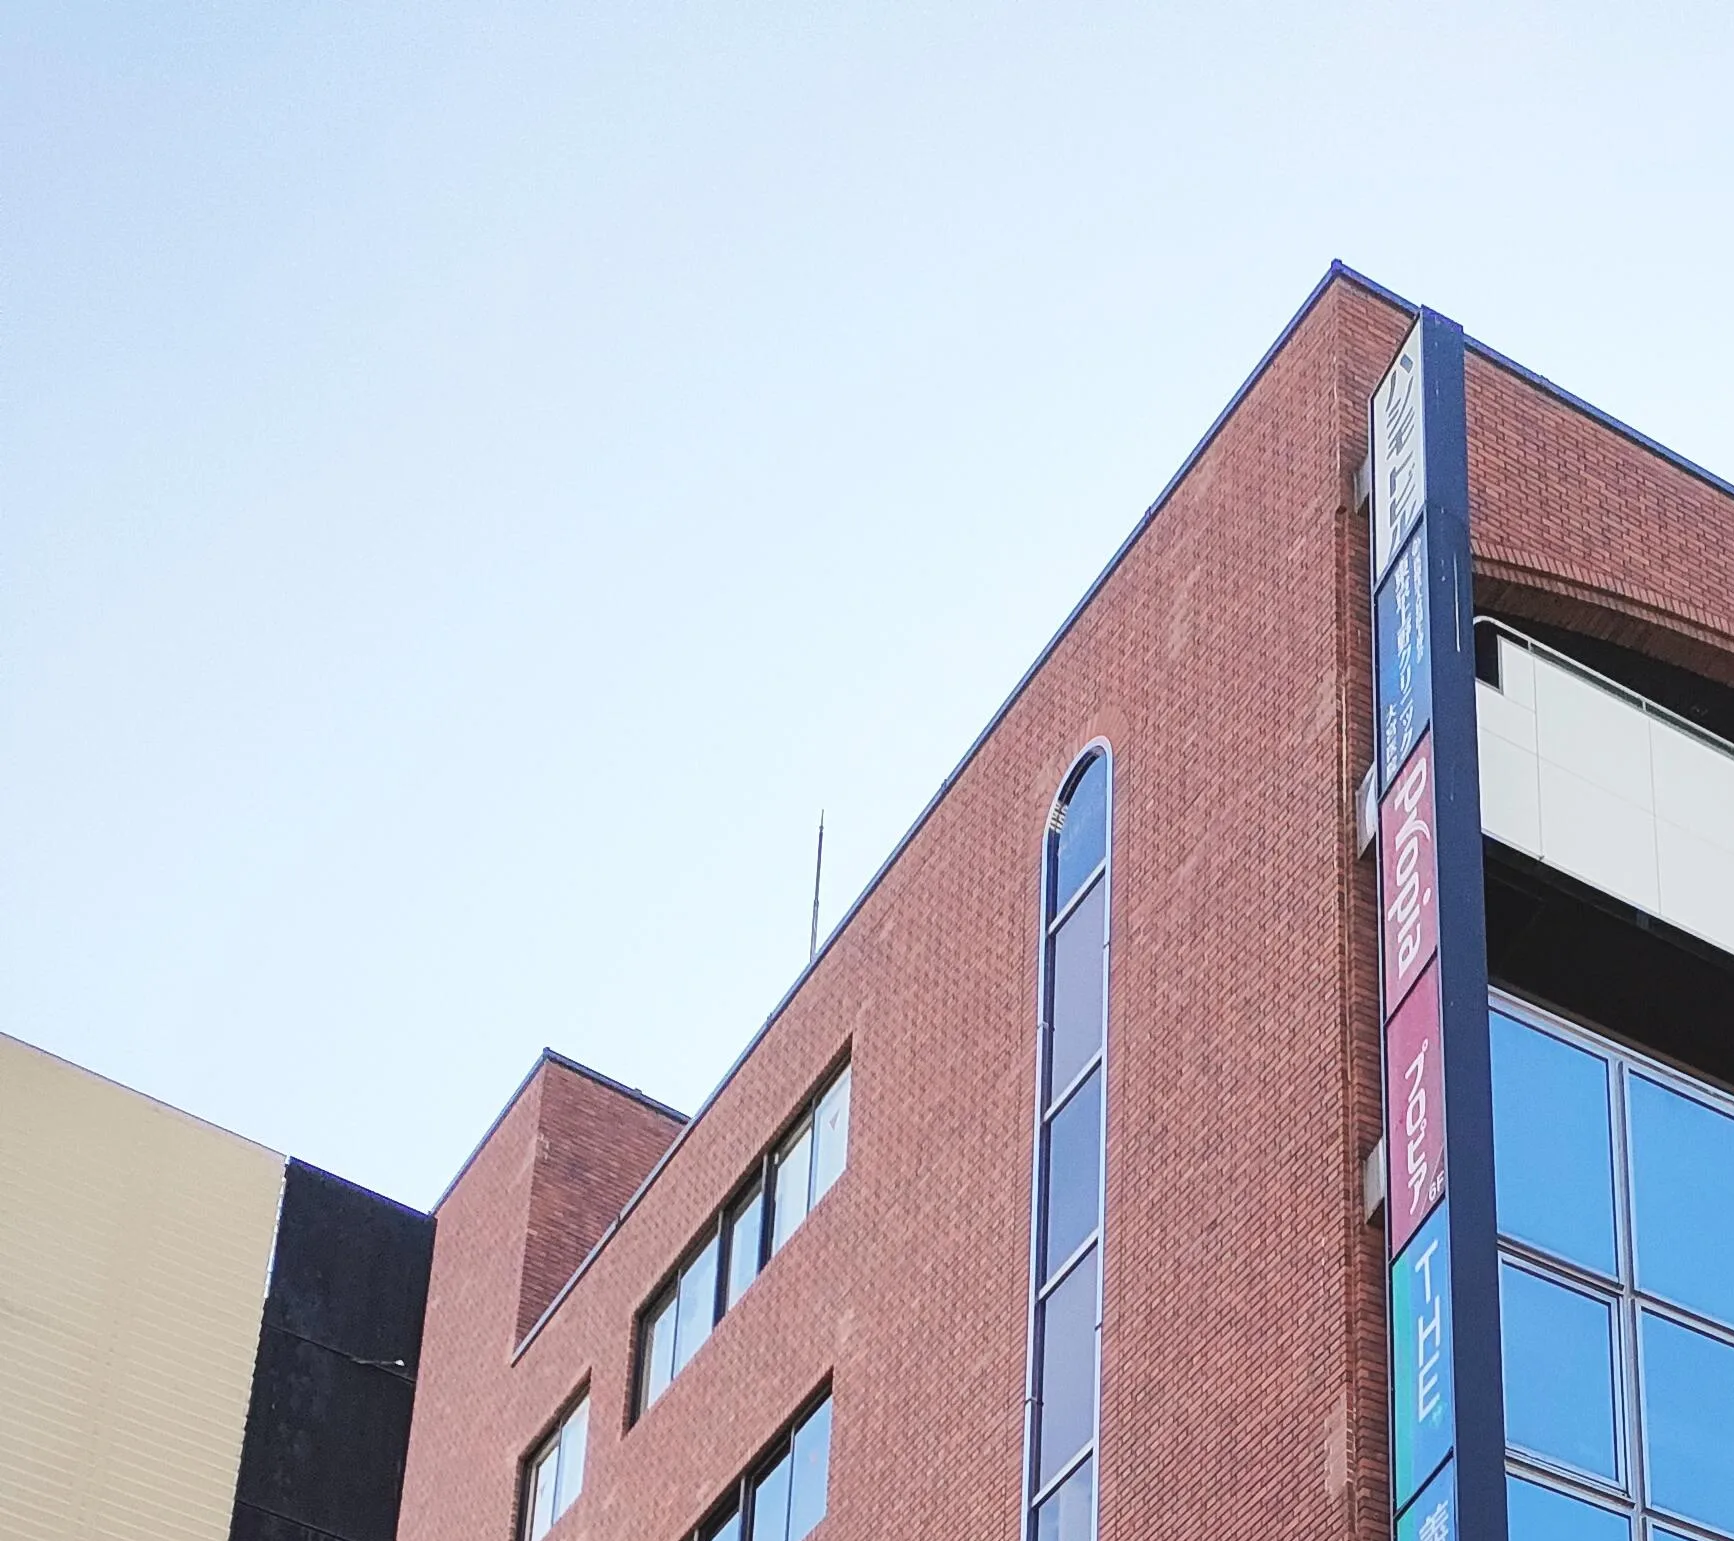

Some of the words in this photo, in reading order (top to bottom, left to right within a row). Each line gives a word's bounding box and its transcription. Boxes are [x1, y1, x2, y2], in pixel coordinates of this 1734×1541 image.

[1386, 354, 1417, 558] ハシモトビル
[1405, 1039, 1428, 1215] プロピア
[1428, 1170, 1445, 1202] 6F
[1414, 1239, 1441, 1421] THE
